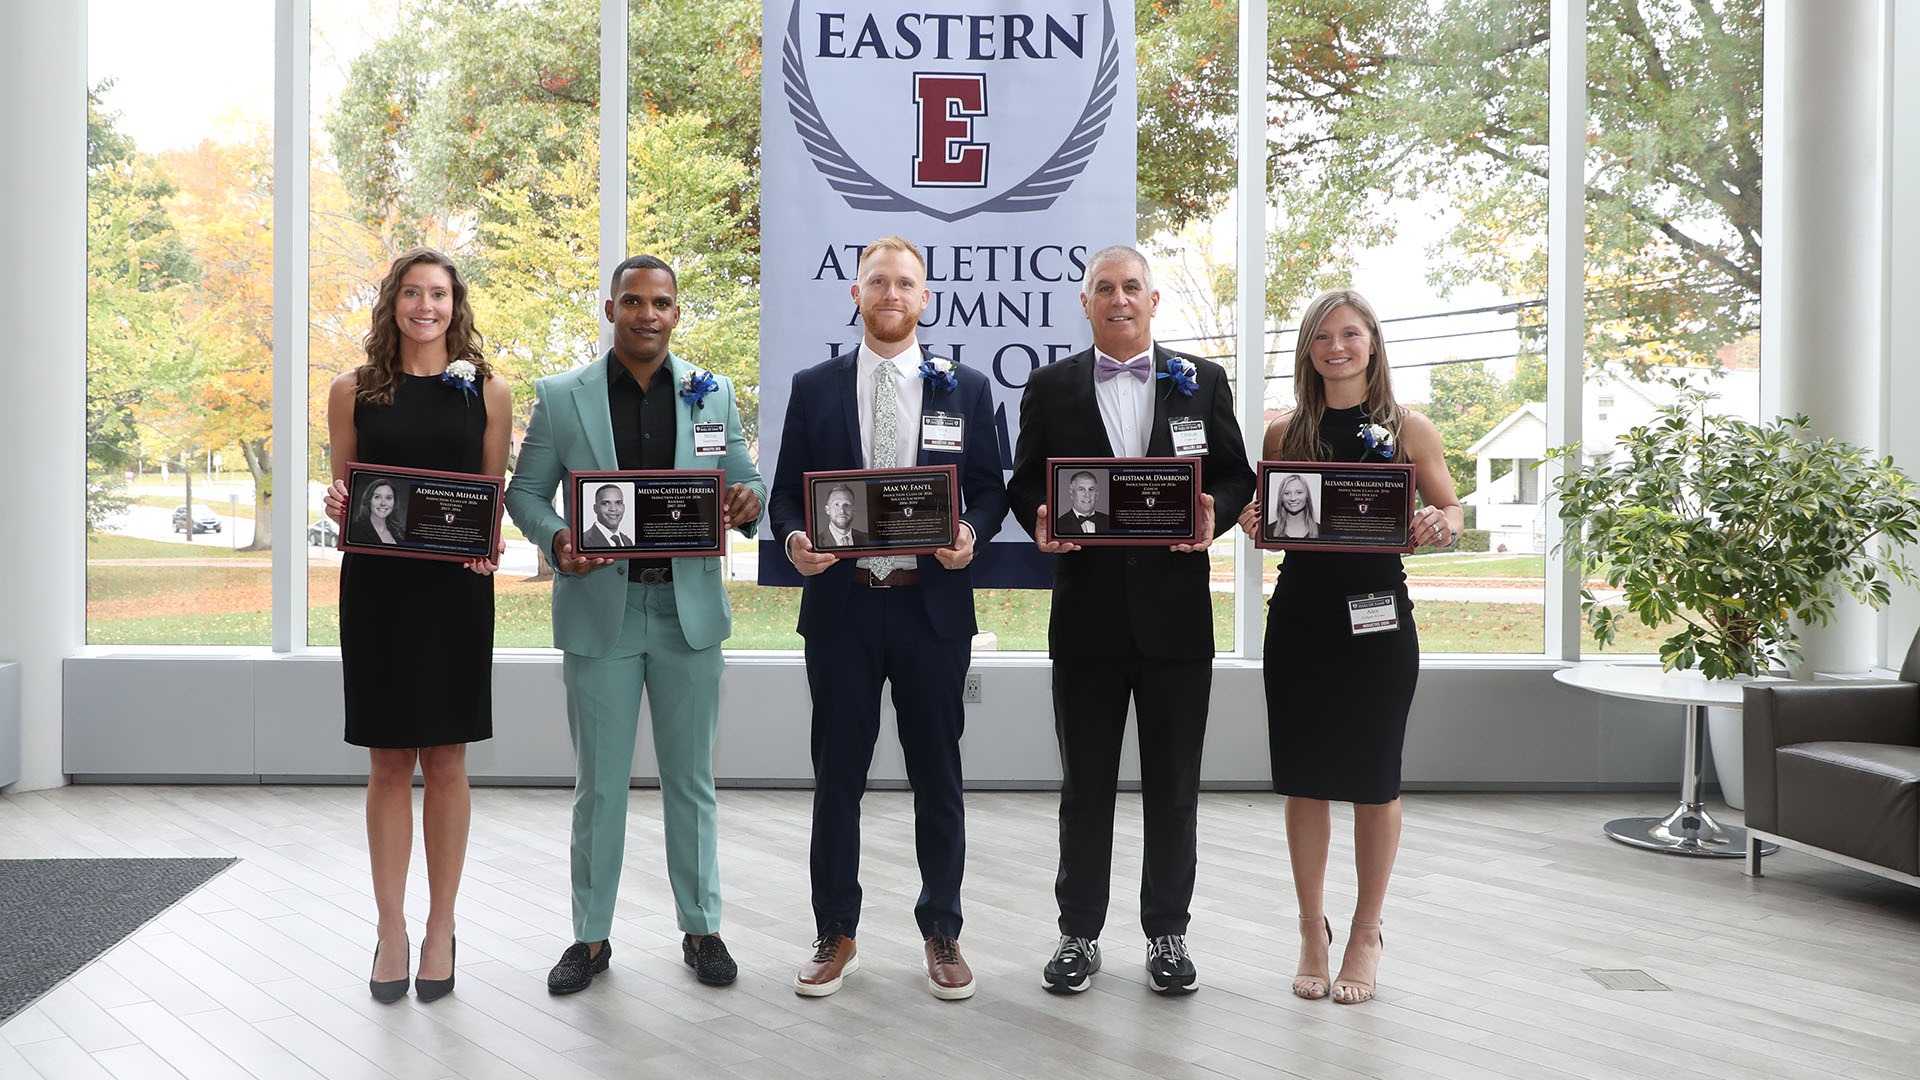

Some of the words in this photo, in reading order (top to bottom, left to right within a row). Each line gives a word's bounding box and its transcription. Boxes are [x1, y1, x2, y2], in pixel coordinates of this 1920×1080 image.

[816, 12, 1088, 60] EASTERN
[912, 71, 990, 188] E
[812, 244, 1088, 282] ATLETICS
[846, 291, 1054, 328] UMNI
[416, 488, 454, 497] ADRIANNA
[456, 492, 488, 500] MIHALEK
